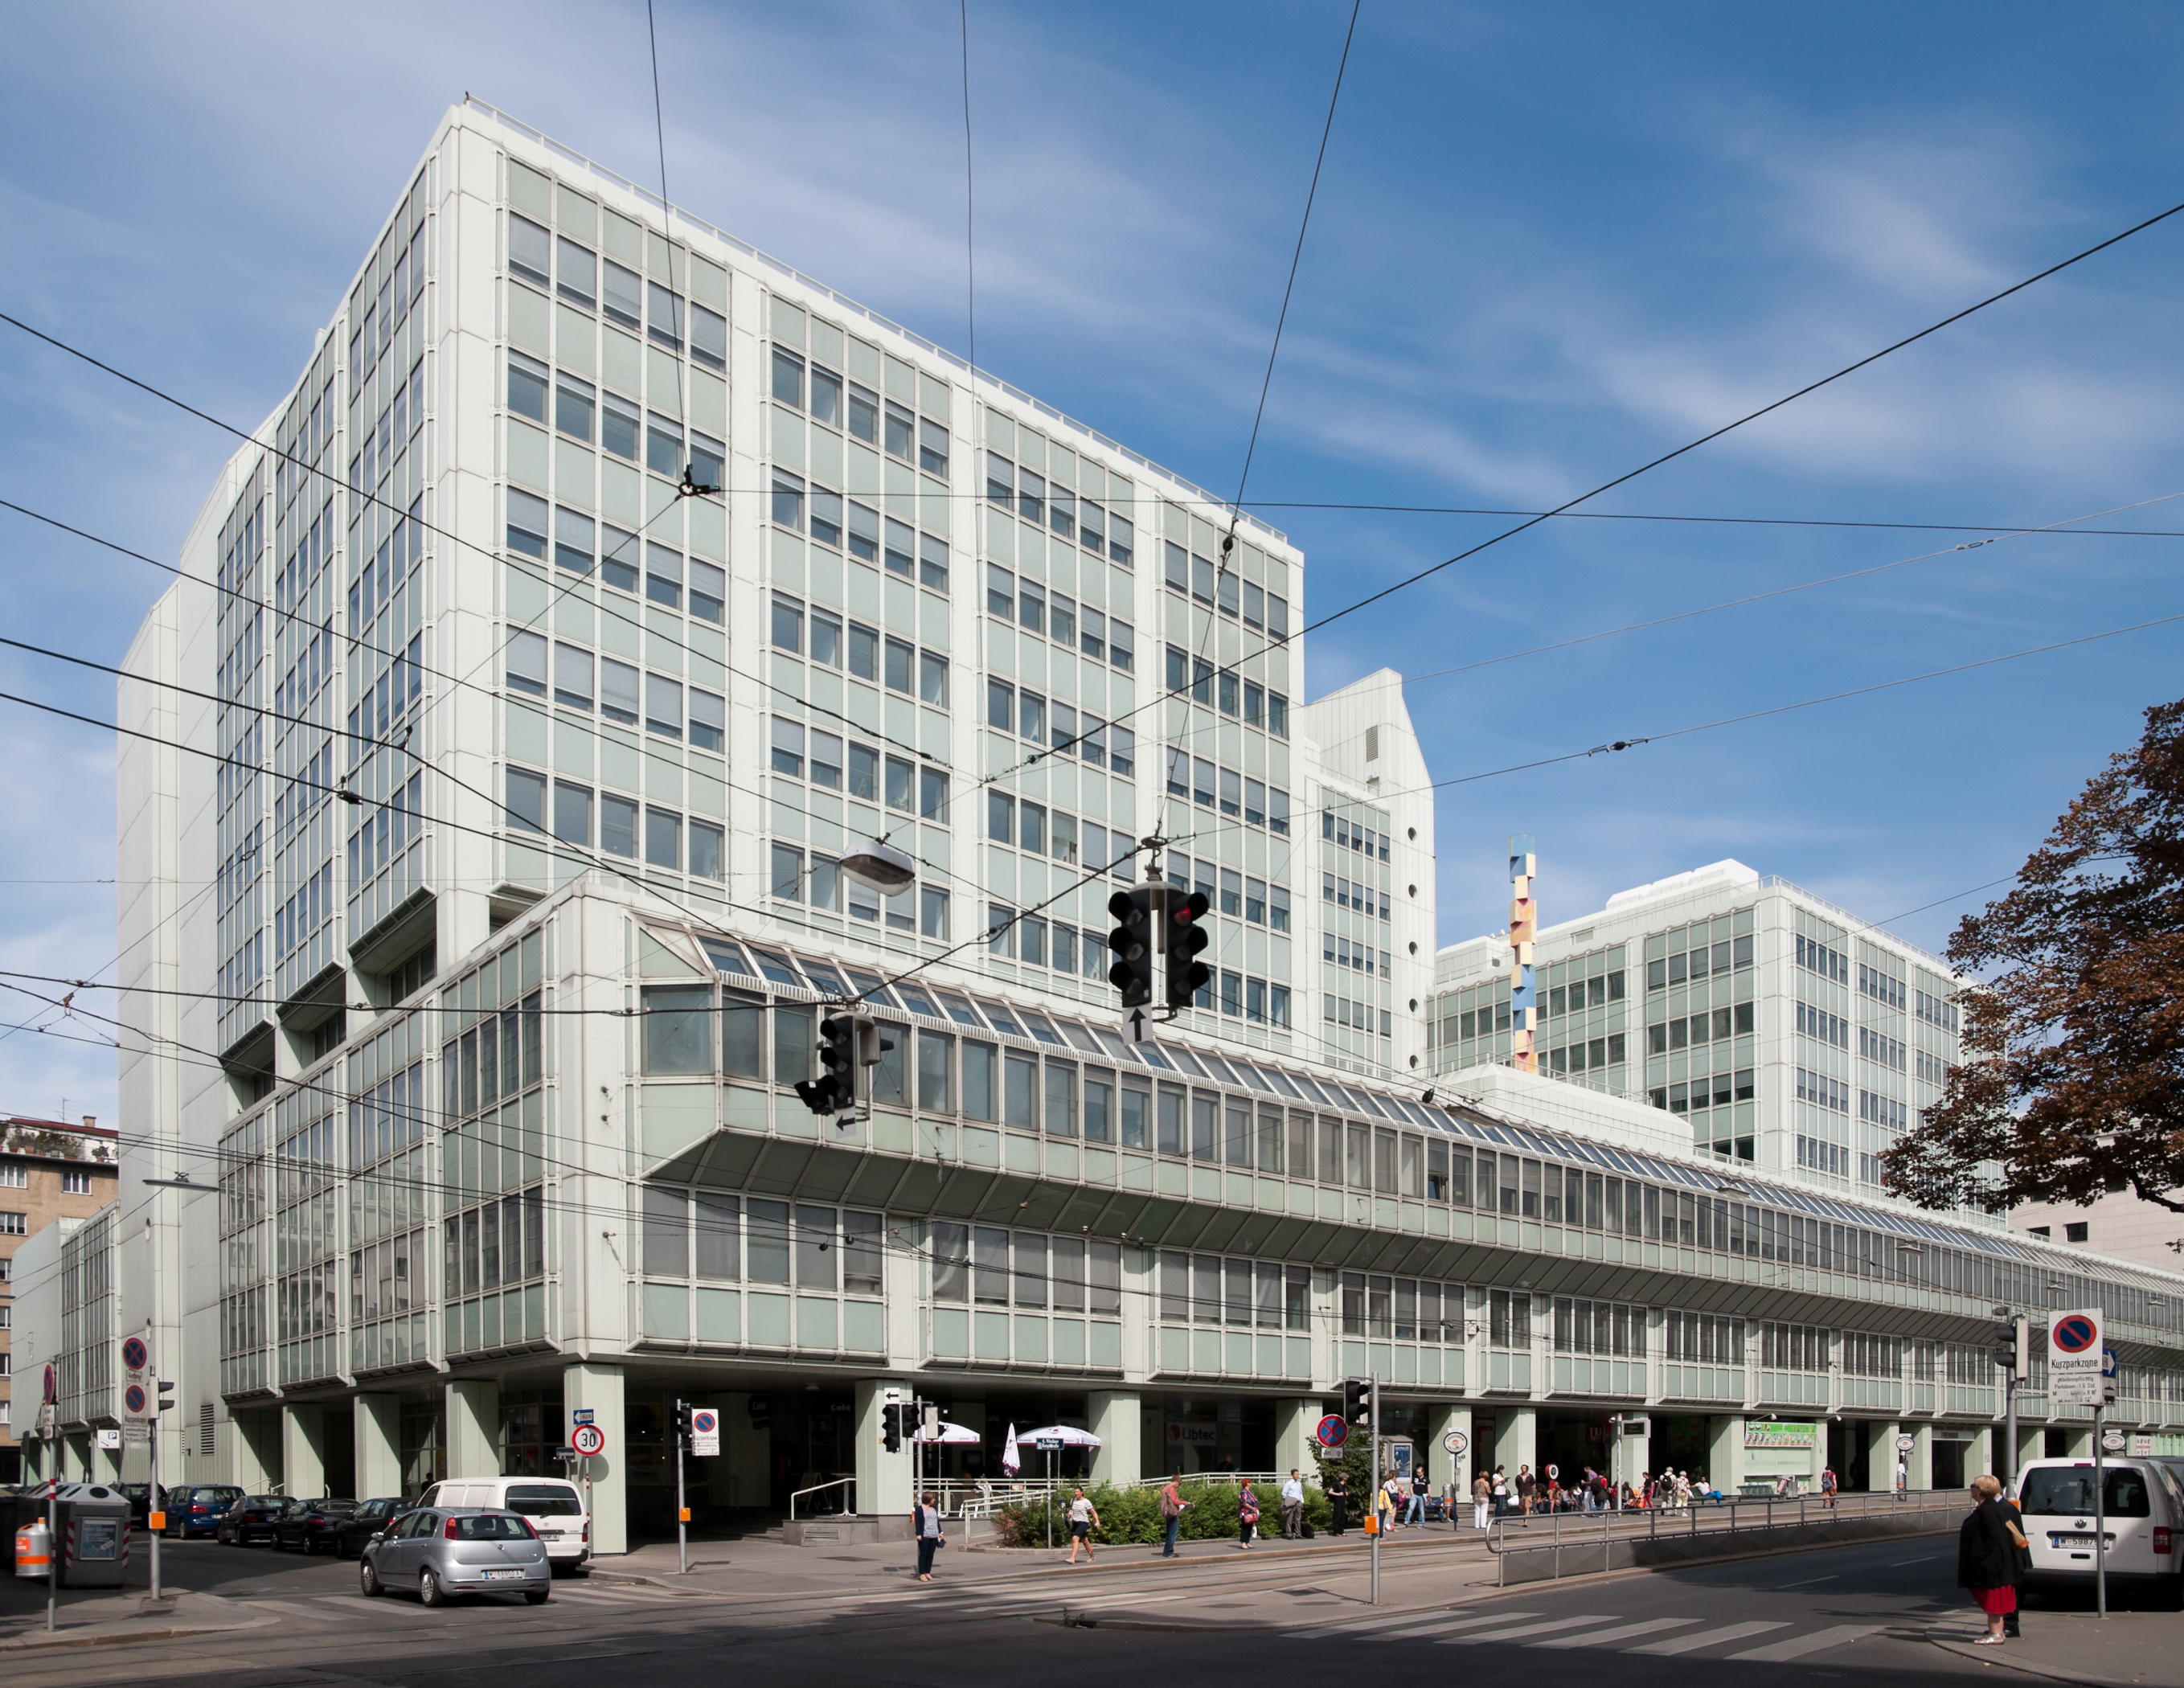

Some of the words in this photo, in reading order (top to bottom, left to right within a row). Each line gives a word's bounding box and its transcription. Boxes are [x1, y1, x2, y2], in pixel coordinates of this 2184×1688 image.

[2051, 1358, 2098, 1370] Kurzparkzone
[830, 1403, 851, 1411] Café
[581, 1433, 596, 1447] 30
[1182, 1428, 1215, 1440] Libtec
